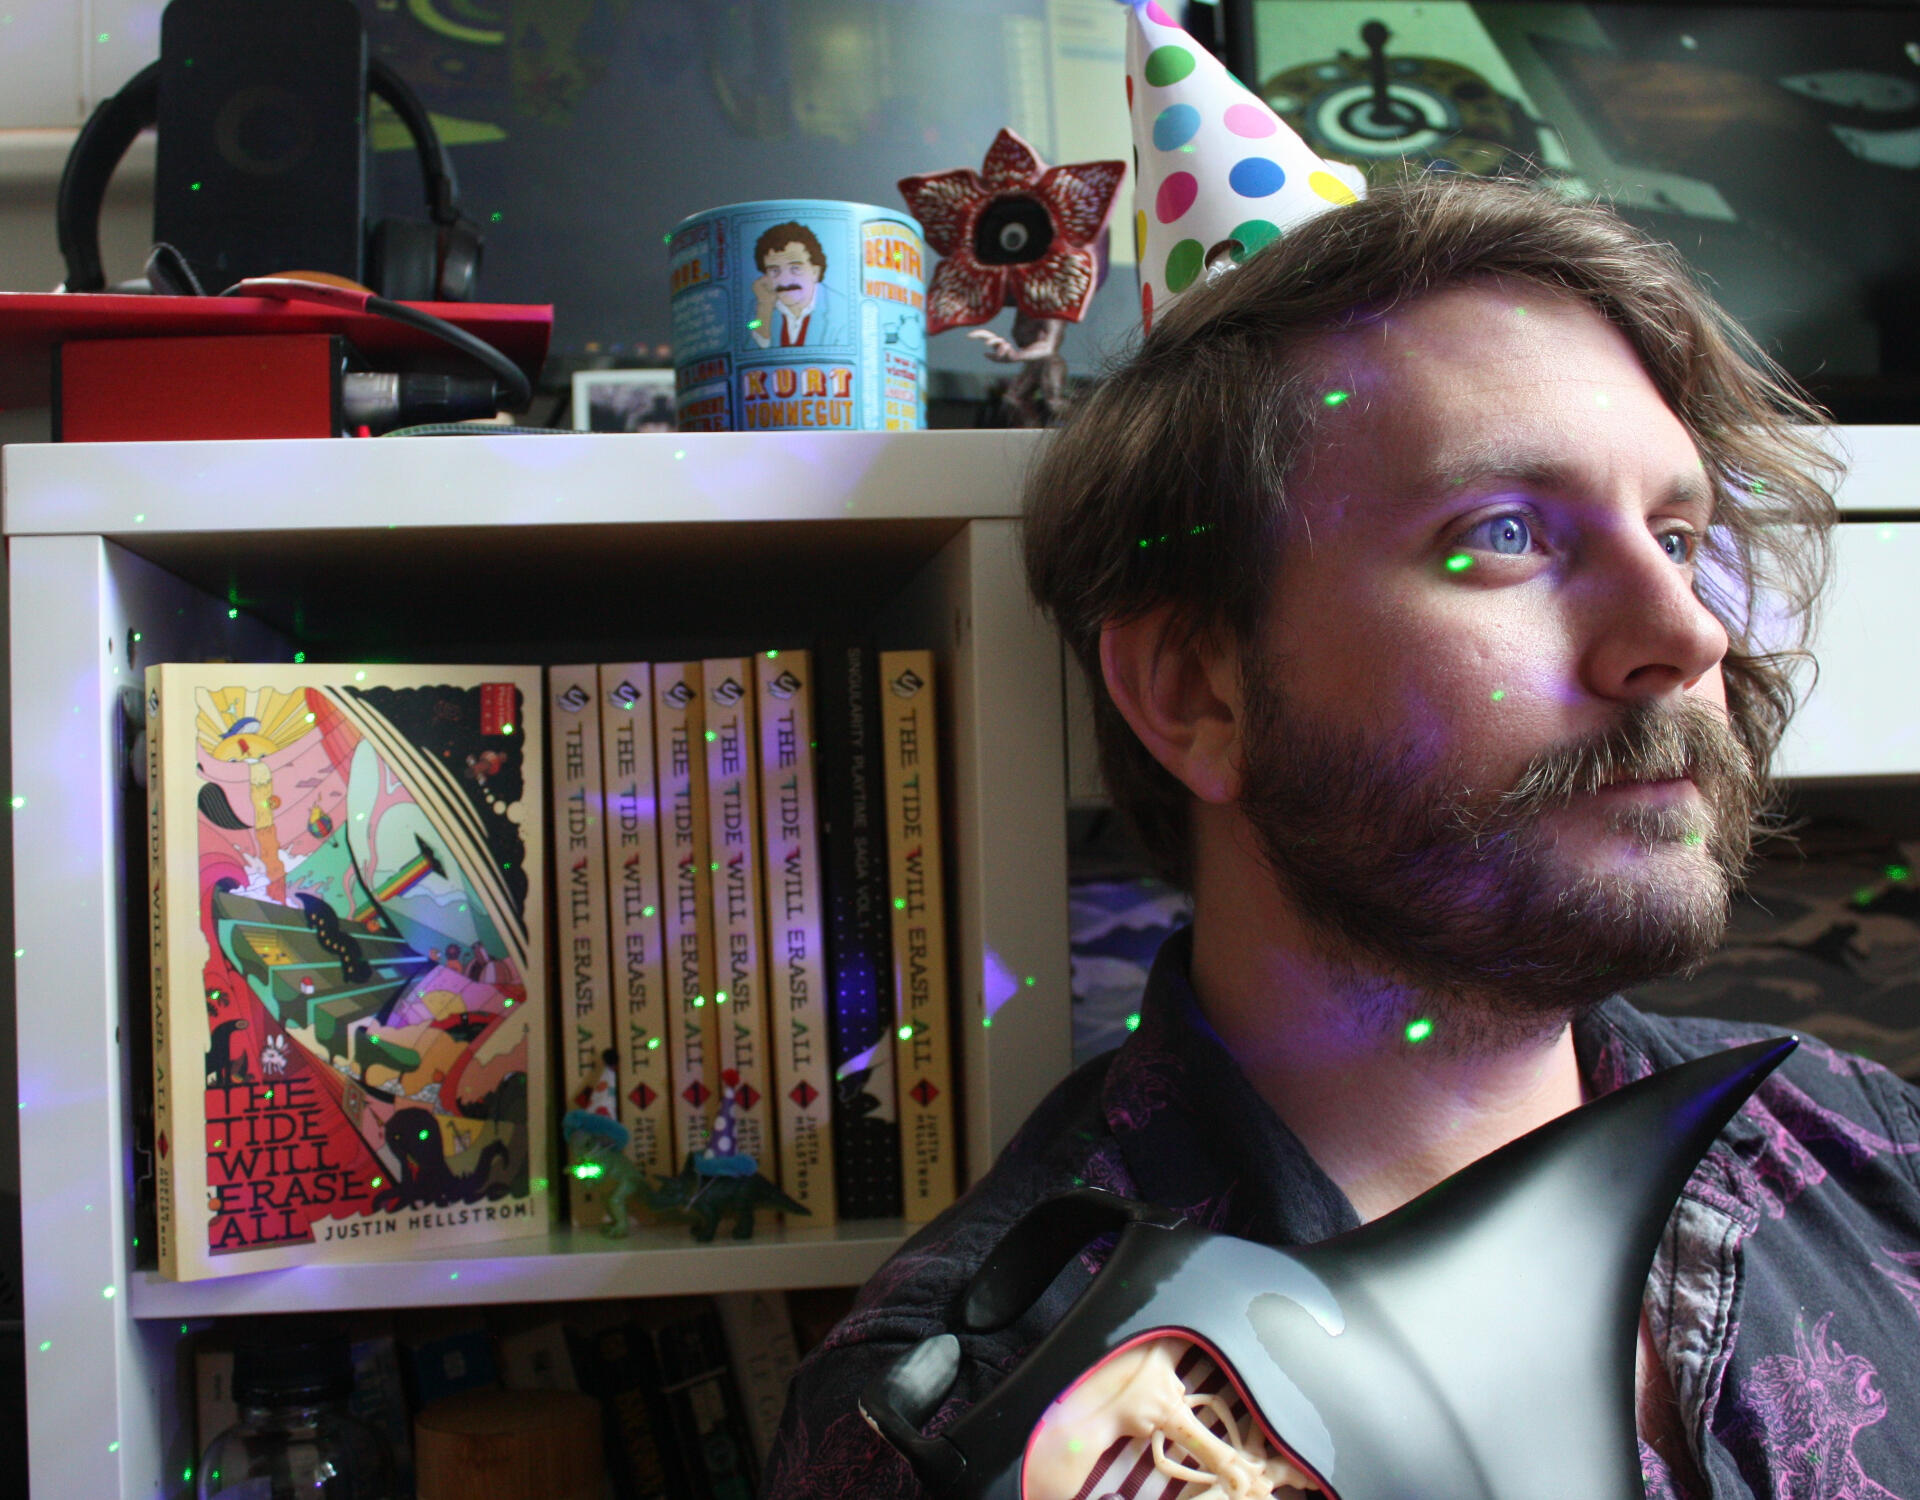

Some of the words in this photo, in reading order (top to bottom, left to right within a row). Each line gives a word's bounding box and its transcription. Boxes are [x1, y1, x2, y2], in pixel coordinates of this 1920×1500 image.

[744, 366, 852, 400] KURT
[745, 400, 853, 429] VONNEGUT
[848, 647, 863, 746] SINGULARITY
[566, 721, 584, 781] THE
[617, 718, 636, 777] THE
[671, 719, 690, 777] THE
[720, 714, 740, 776] THE
[778, 708, 797, 769] THE
[900, 707, 919, 770] THE
[568, 786, 587, 851] TIDE
[619, 781, 639, 848] TIDE
[674, 781, 693, 848] TIDE
[723, 780, 743, 847] TIDE
[780, 773, 798, 841] TIDE
[851, 755, 868, 828] PLAYTIME
[902, 772, 922, 840] TIDE
[623, 852, 643, 926] WILL
[678, 852, 697, 926] WILL
[727, 851, 747, 926] WILL
[784, 845, 804, 921] WILL
[853, 836, 869, 879] SAGA
[905, 844, 926, 920] WILL
[571, 857, 590, 928] WILL
[573, 936, 593, 1019] ERASE
[626, 934, 647, 1016] ERASE
[681, 933, 700, 1016] ERASE
[730, 933, 749, 1016] ERASE
[787, 928, 808, 1012] ERASE
[909, 927, 929, 1011] ERASE
[576, 1023, 596, 1077] ALL
[630, 1020, 649, 1075] ALL
[683, 1020, 703, 1073] ALL
[733, 1021, 753, 1075] ALL
[792, 1018, 811, 1073] ALL
[912, 1017, 932, 1071] ALL
[206, 1077, 317, 1115] THE
[205, 1108, 327, 1148] TIDE
[795, 1116, 809, 1200] HELLSTROM
[807, 1117, 819, 1165] JUSTIN
[207, 1141, 341, 1181] WILL
[217, 1171, 370, 1216] ERASE
[325, 1220, 397, 1242] JUSTIN
[409, 1204, 527, 1231] HELLSTROM
[210, 1209, 308, 1249] ALL
